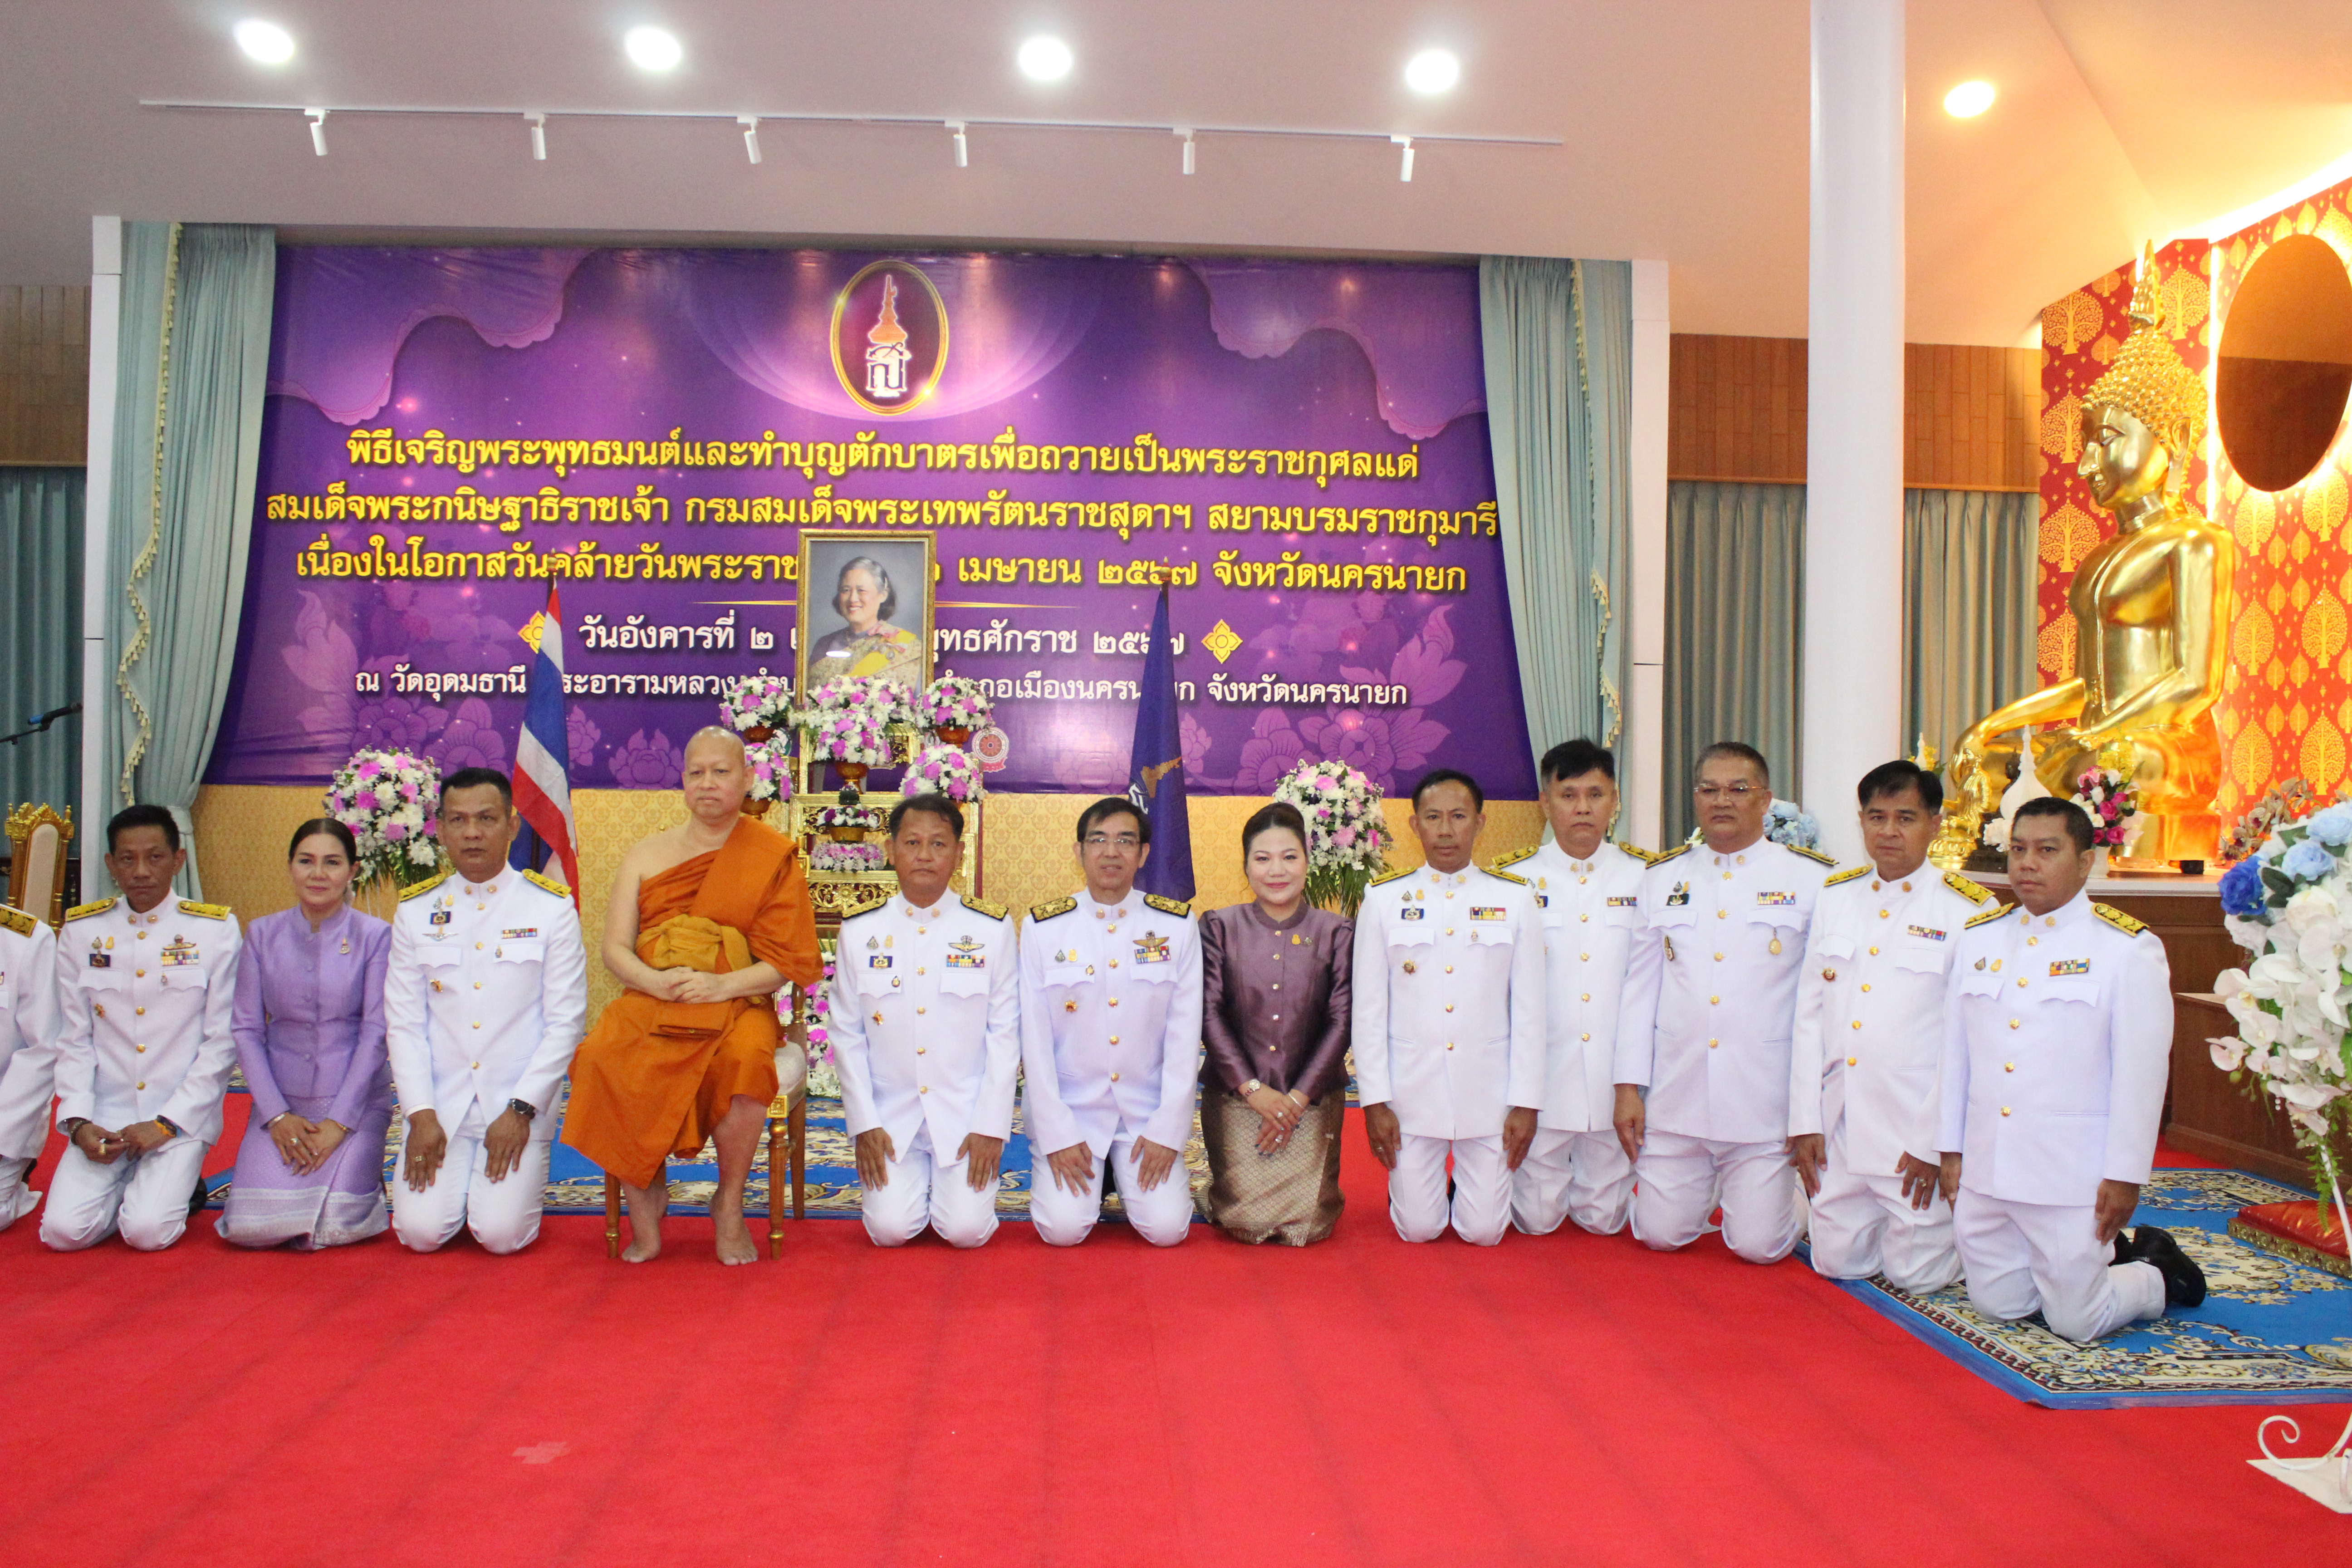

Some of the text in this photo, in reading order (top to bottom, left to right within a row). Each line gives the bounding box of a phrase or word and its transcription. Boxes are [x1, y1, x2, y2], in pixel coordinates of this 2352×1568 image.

[346, 425, 1418, 487] พิธีเจริญพระพุทธมนต์และทำบุญตักบาตรเพื่อถวายเป็นพระราชกุศลแด่
[266, 481, 1497, 547] สมเด็จพระกนิษฐาธิราชเจ้า กรมสมเด็จพระเทพรัตนราชสุดาฯ สยามบรมราชกุมารี
[297, 533, 798, 580] เนื่องในโอกาสวันคล้ายวันพระราช
[958, 556, 1082, 584] เมษายน
[1212, 550, 1466, 591] จังหวัดนครนายก
[578, 609, 735, 649] วันอังคารที่
[750, 627, 774, 649] ๒
[355, 671, 379, 692] ณ
[390, 663, 527, 703] วัดอุดมธานี
[562, 673, 736, 694] ระอารามหลวง
[1207, 672, 1407, 705] จังหวัดนครนายก
